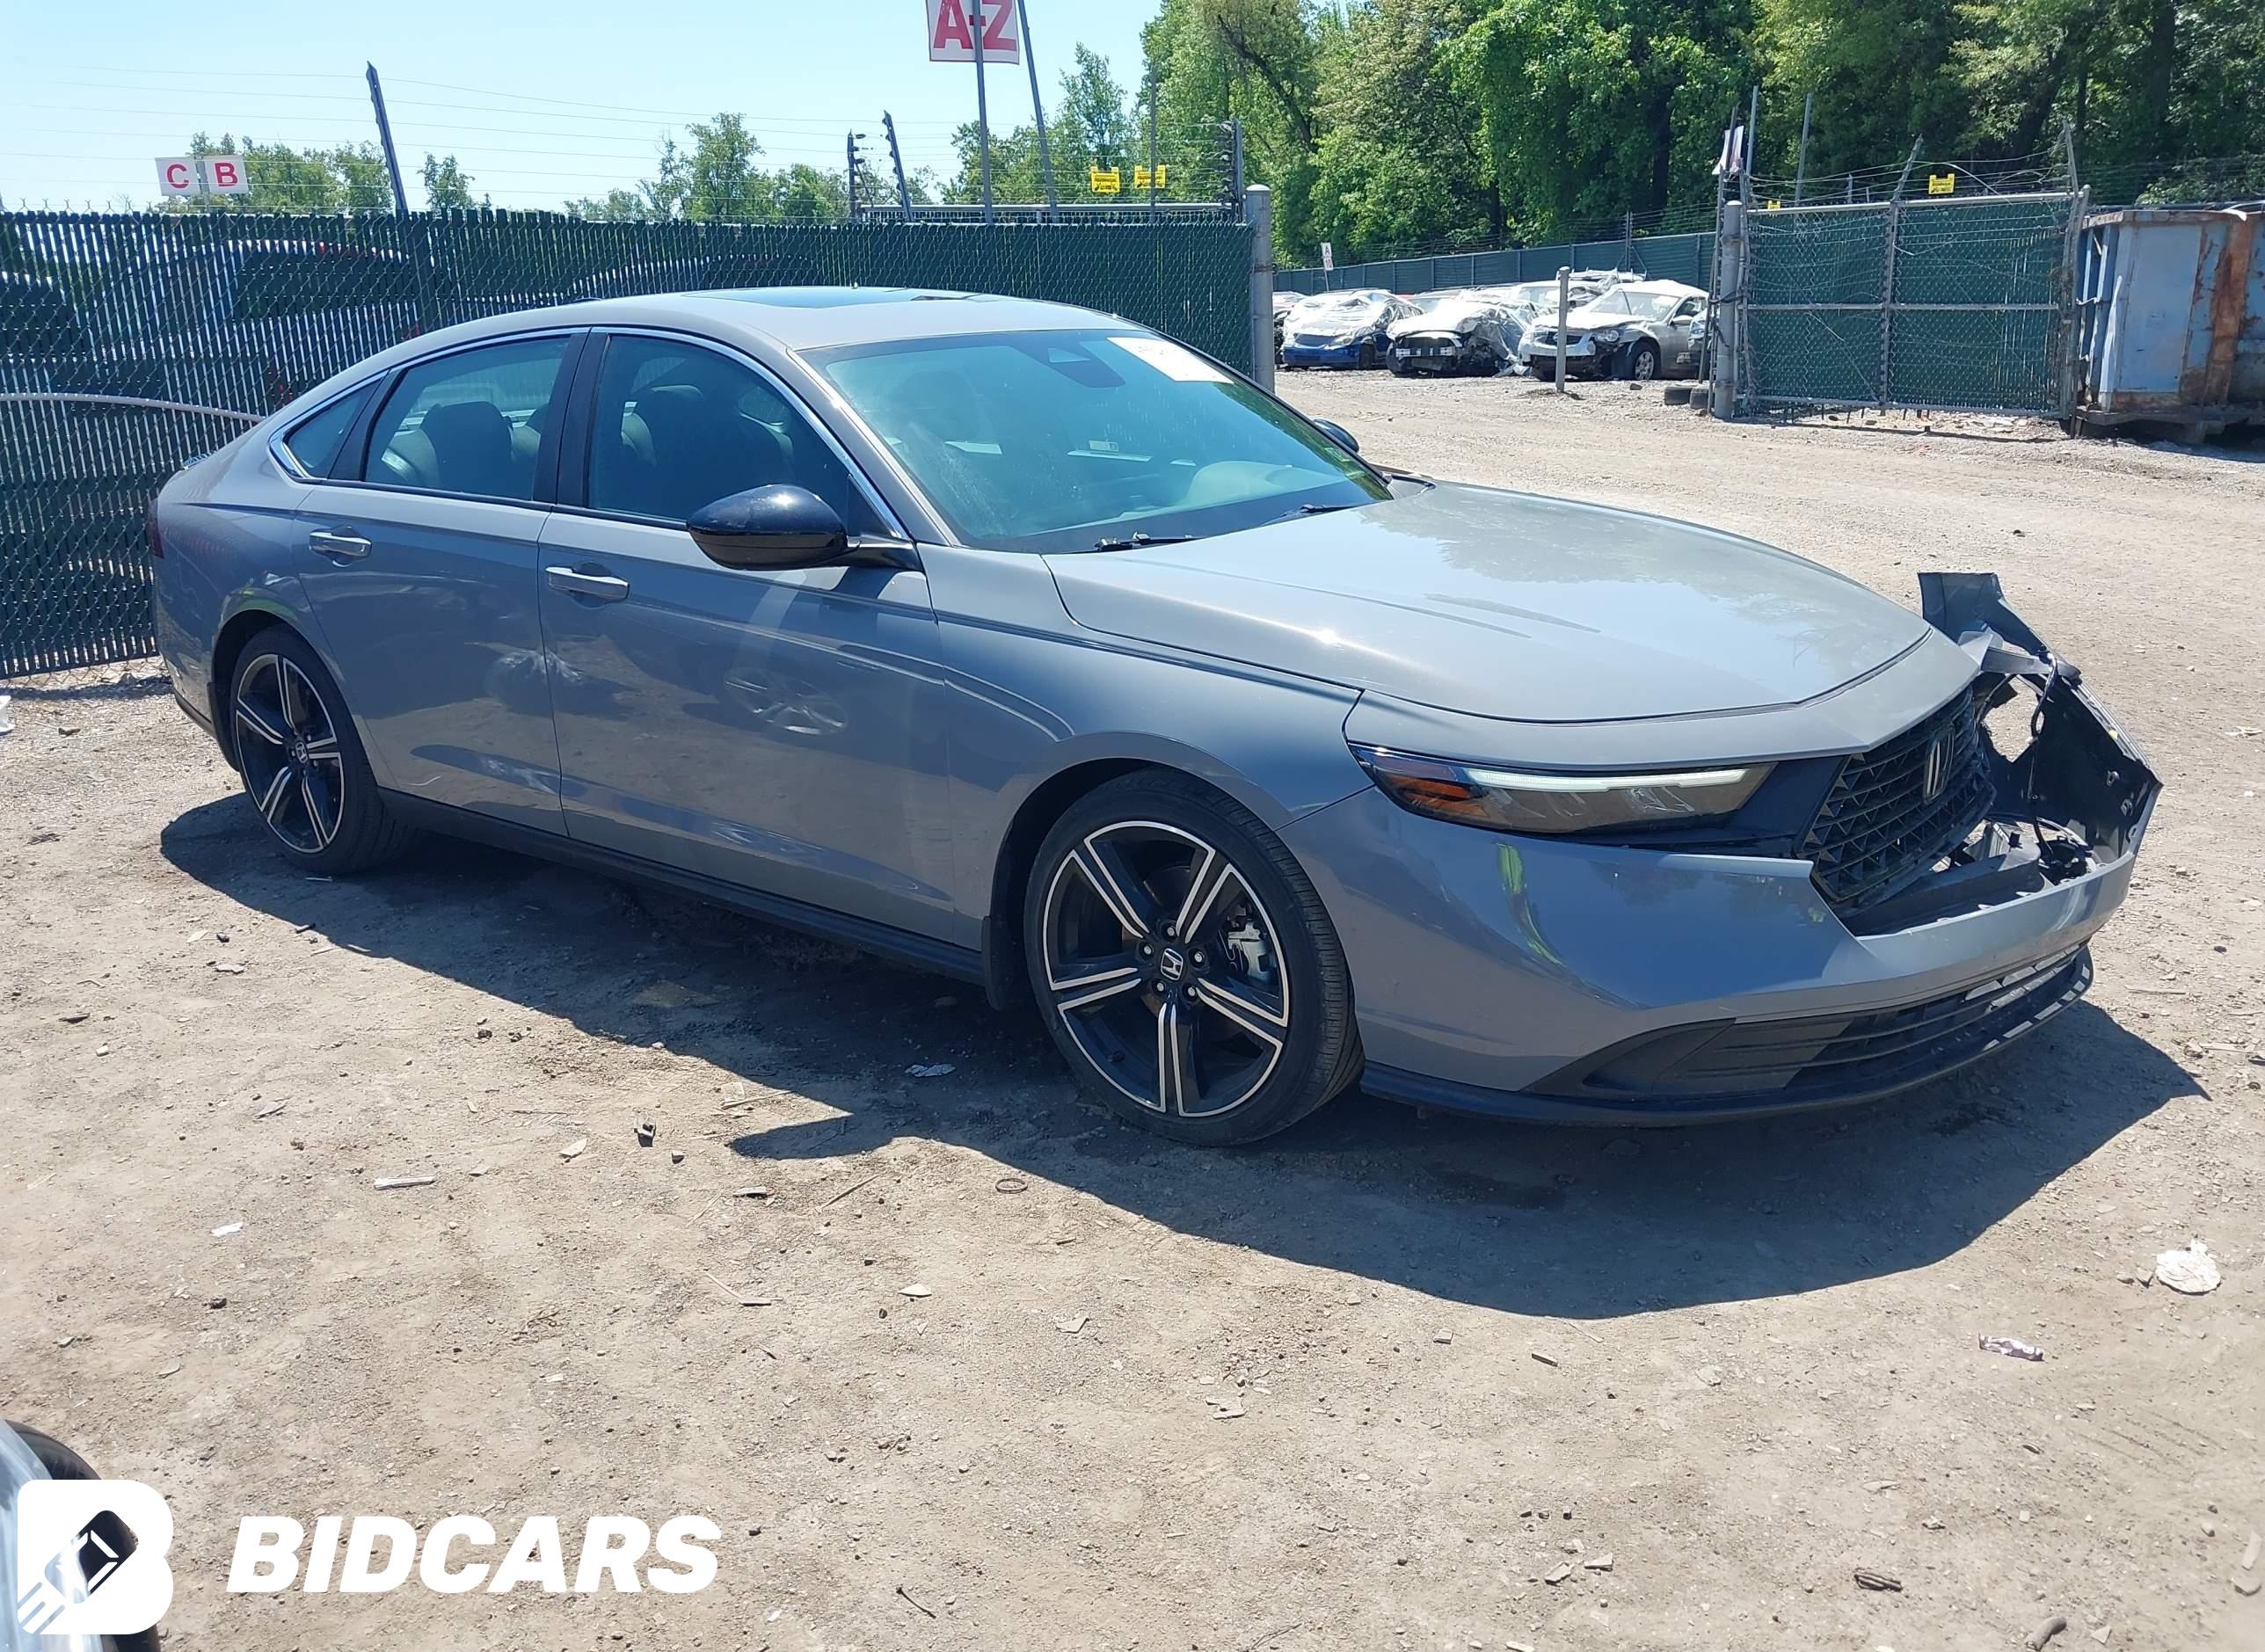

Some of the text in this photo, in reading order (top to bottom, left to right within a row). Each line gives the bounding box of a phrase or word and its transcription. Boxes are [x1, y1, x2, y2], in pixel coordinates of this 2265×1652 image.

[166, 163, 190, 189] C
[214, 162, 238, 187] B
[1324, 245, 1330, 255] A
